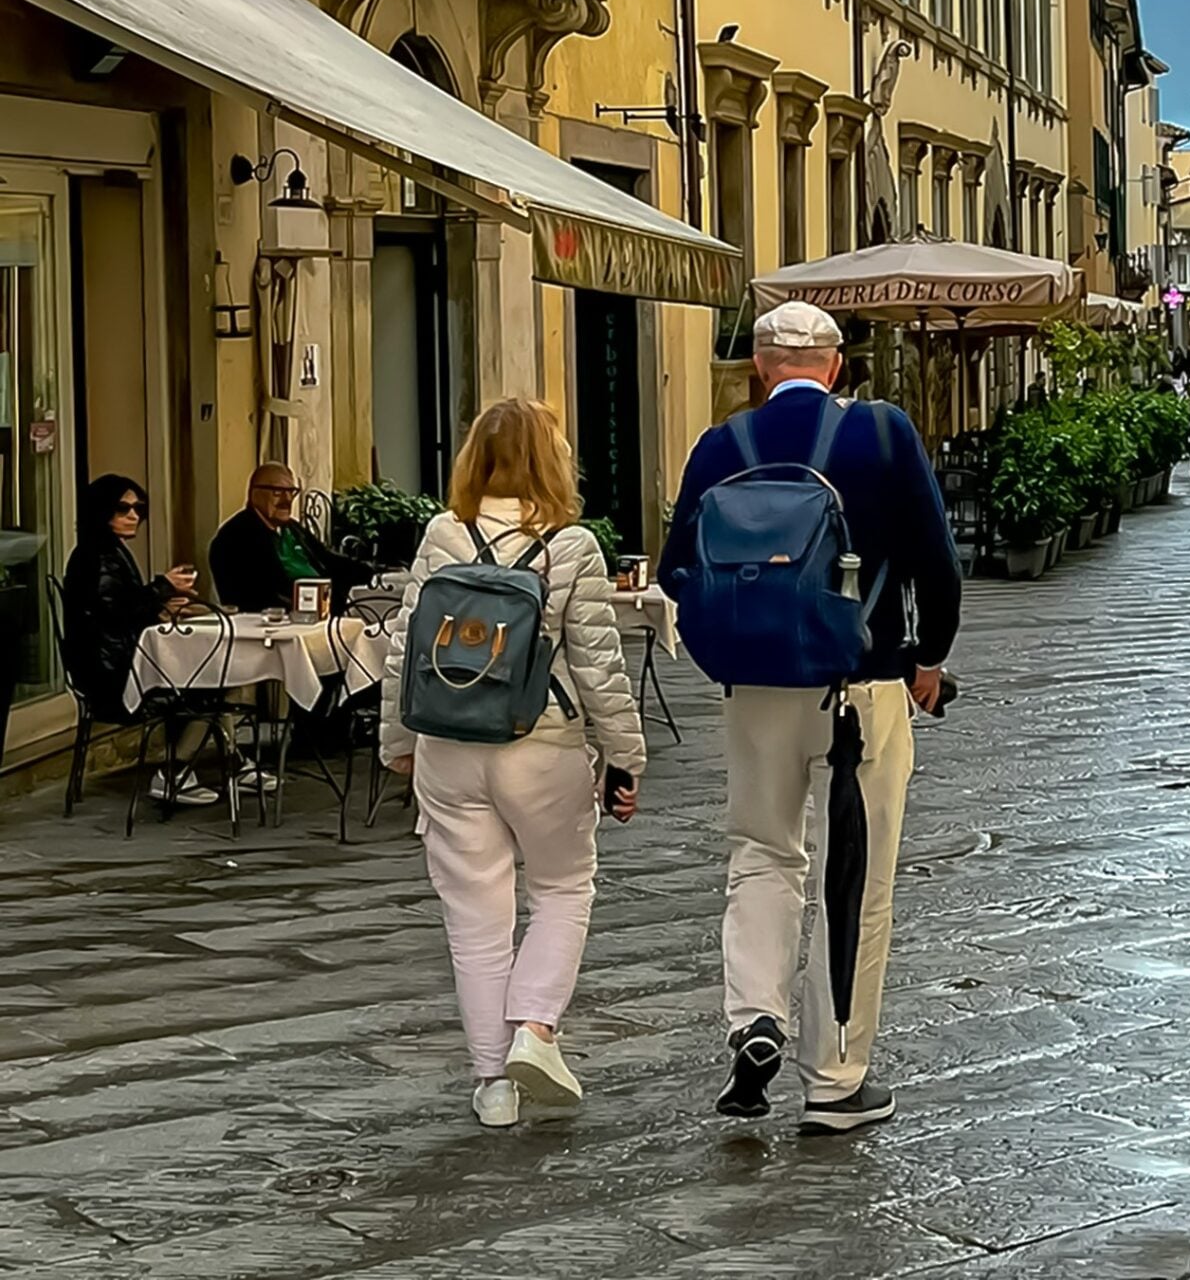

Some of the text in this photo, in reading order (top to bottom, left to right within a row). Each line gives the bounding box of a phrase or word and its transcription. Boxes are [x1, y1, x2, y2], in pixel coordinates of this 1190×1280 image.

[787, 281, 1023, 306] PIZZERIA DEL CORSO
